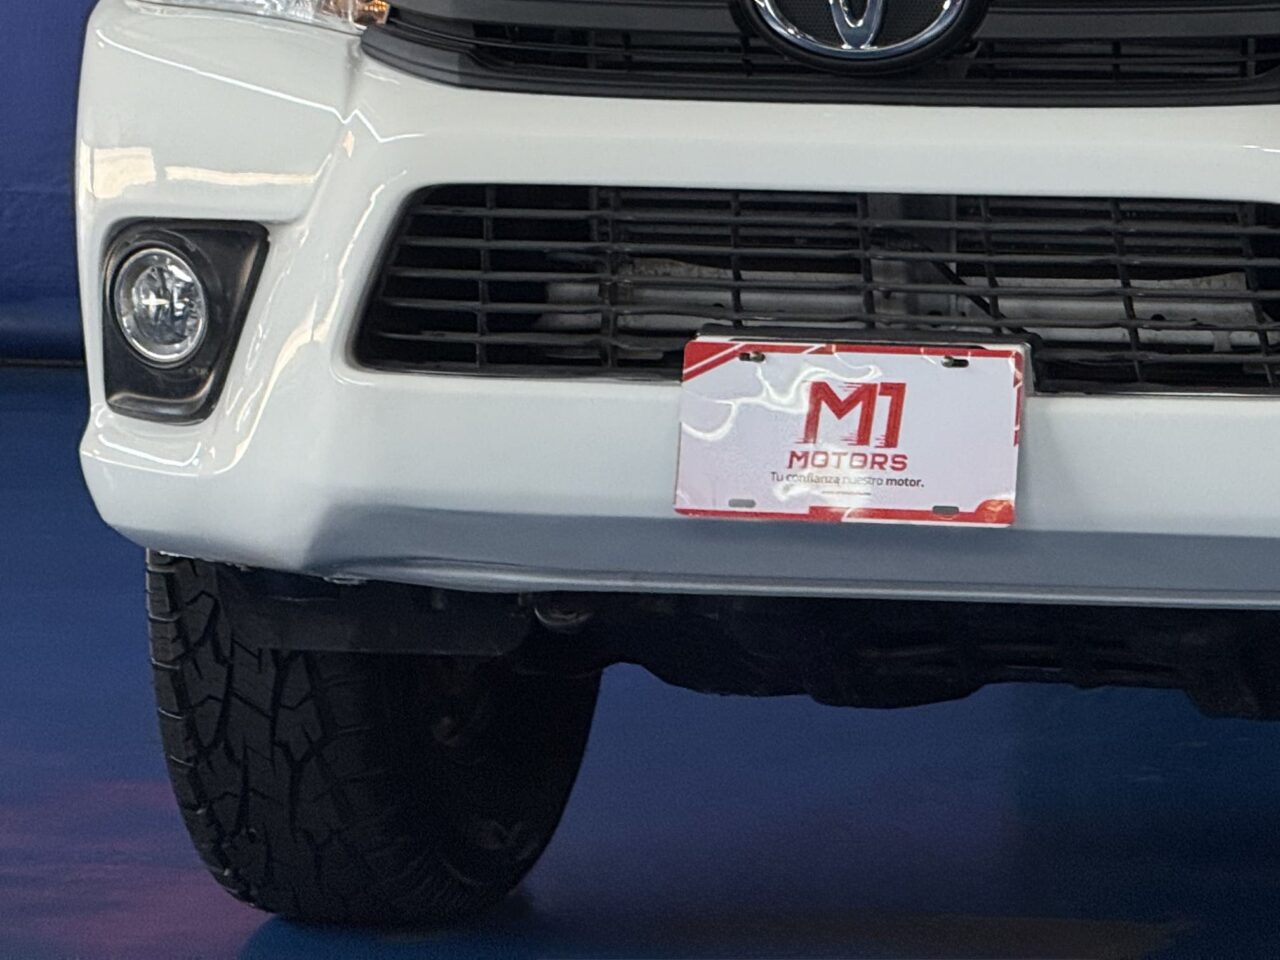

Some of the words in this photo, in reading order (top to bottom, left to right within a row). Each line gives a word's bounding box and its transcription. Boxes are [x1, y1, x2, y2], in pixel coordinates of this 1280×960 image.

[795, 380, 907, 449] M1
[786, 450, 909, 472] MOTORS
[770, 471, 784, 483] Tu
[842, 475, 884, 487] nuestro
[886, 477, 925, 488] motor.
